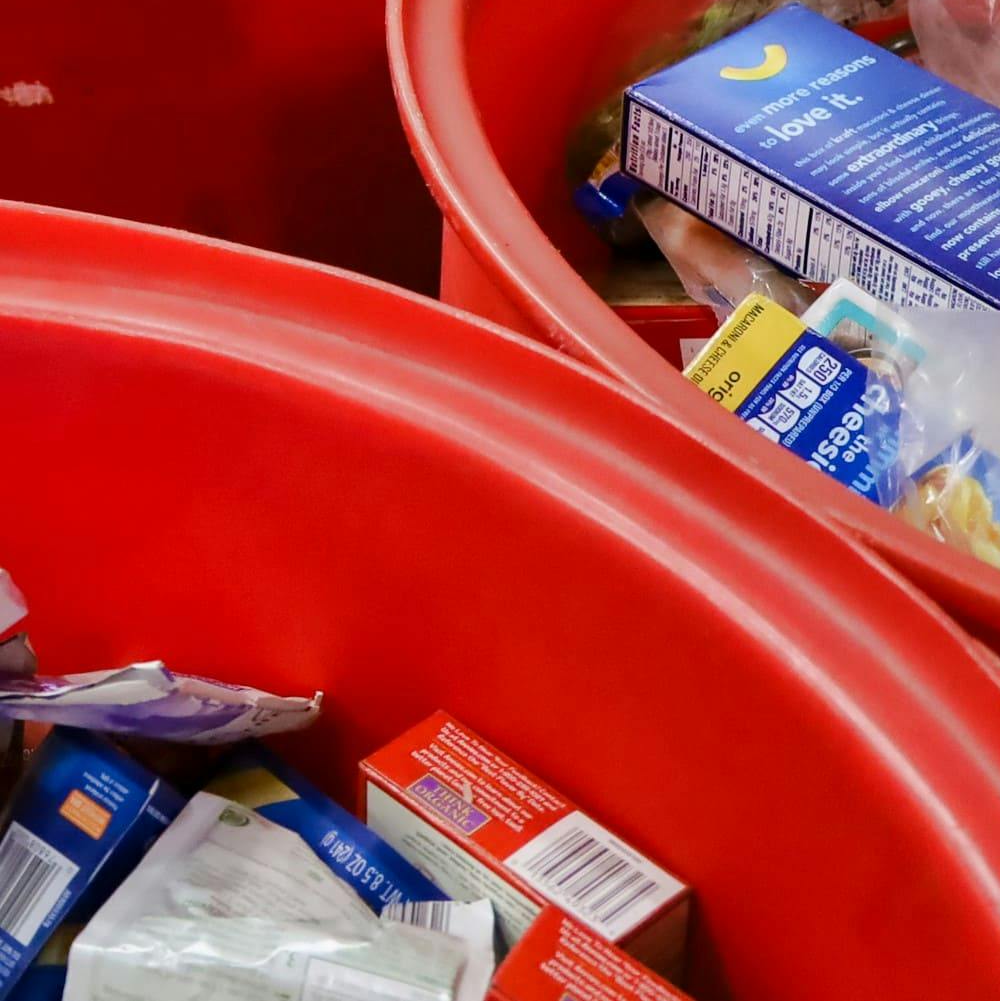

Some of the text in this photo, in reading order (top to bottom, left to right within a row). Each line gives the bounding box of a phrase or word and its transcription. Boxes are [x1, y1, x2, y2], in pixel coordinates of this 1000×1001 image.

[735, 56, 875, 133] even more reasons
[628, 108, 642, 174] Nutrition Facts
[760, 94, 862, 148] to love it.
[830, 129, 857, 143] kraft
[963, 123, 1000, 142] delicious
[848, 122, 937, 172] extraordinary
[875, 192, 903, 212] elbow
[903, 167, 943, 193] macaroni
[894, 210, 912, 222] with
[911, 187, 950, 212] gooey,
[949, 164, 987, 186] cheesy
[910, 219, 926, 232] and
[943, 196, 964, 209] there
[964, 188, 977, 197] are
[980, 176, 997, 186] few
[941, 233, 964, 250] now
[976, 256, 991, 269] still
[721, 339, 731, 348] &
[728, 304, 764, 342] MACARONI
[698, 347, 726, 374] CHEESE
[813, 358, 841, 384] 250
[707, 372, 740, 407] orig
[783, 368, 852, 446] PER 1/3 BOX (UNPREPARED)
[843, 435, 873, 462] the
[414, 784, 474, 828] ORGANIC
[322, 830, 402, 908] WT. 8.5 OZ (241 g)
